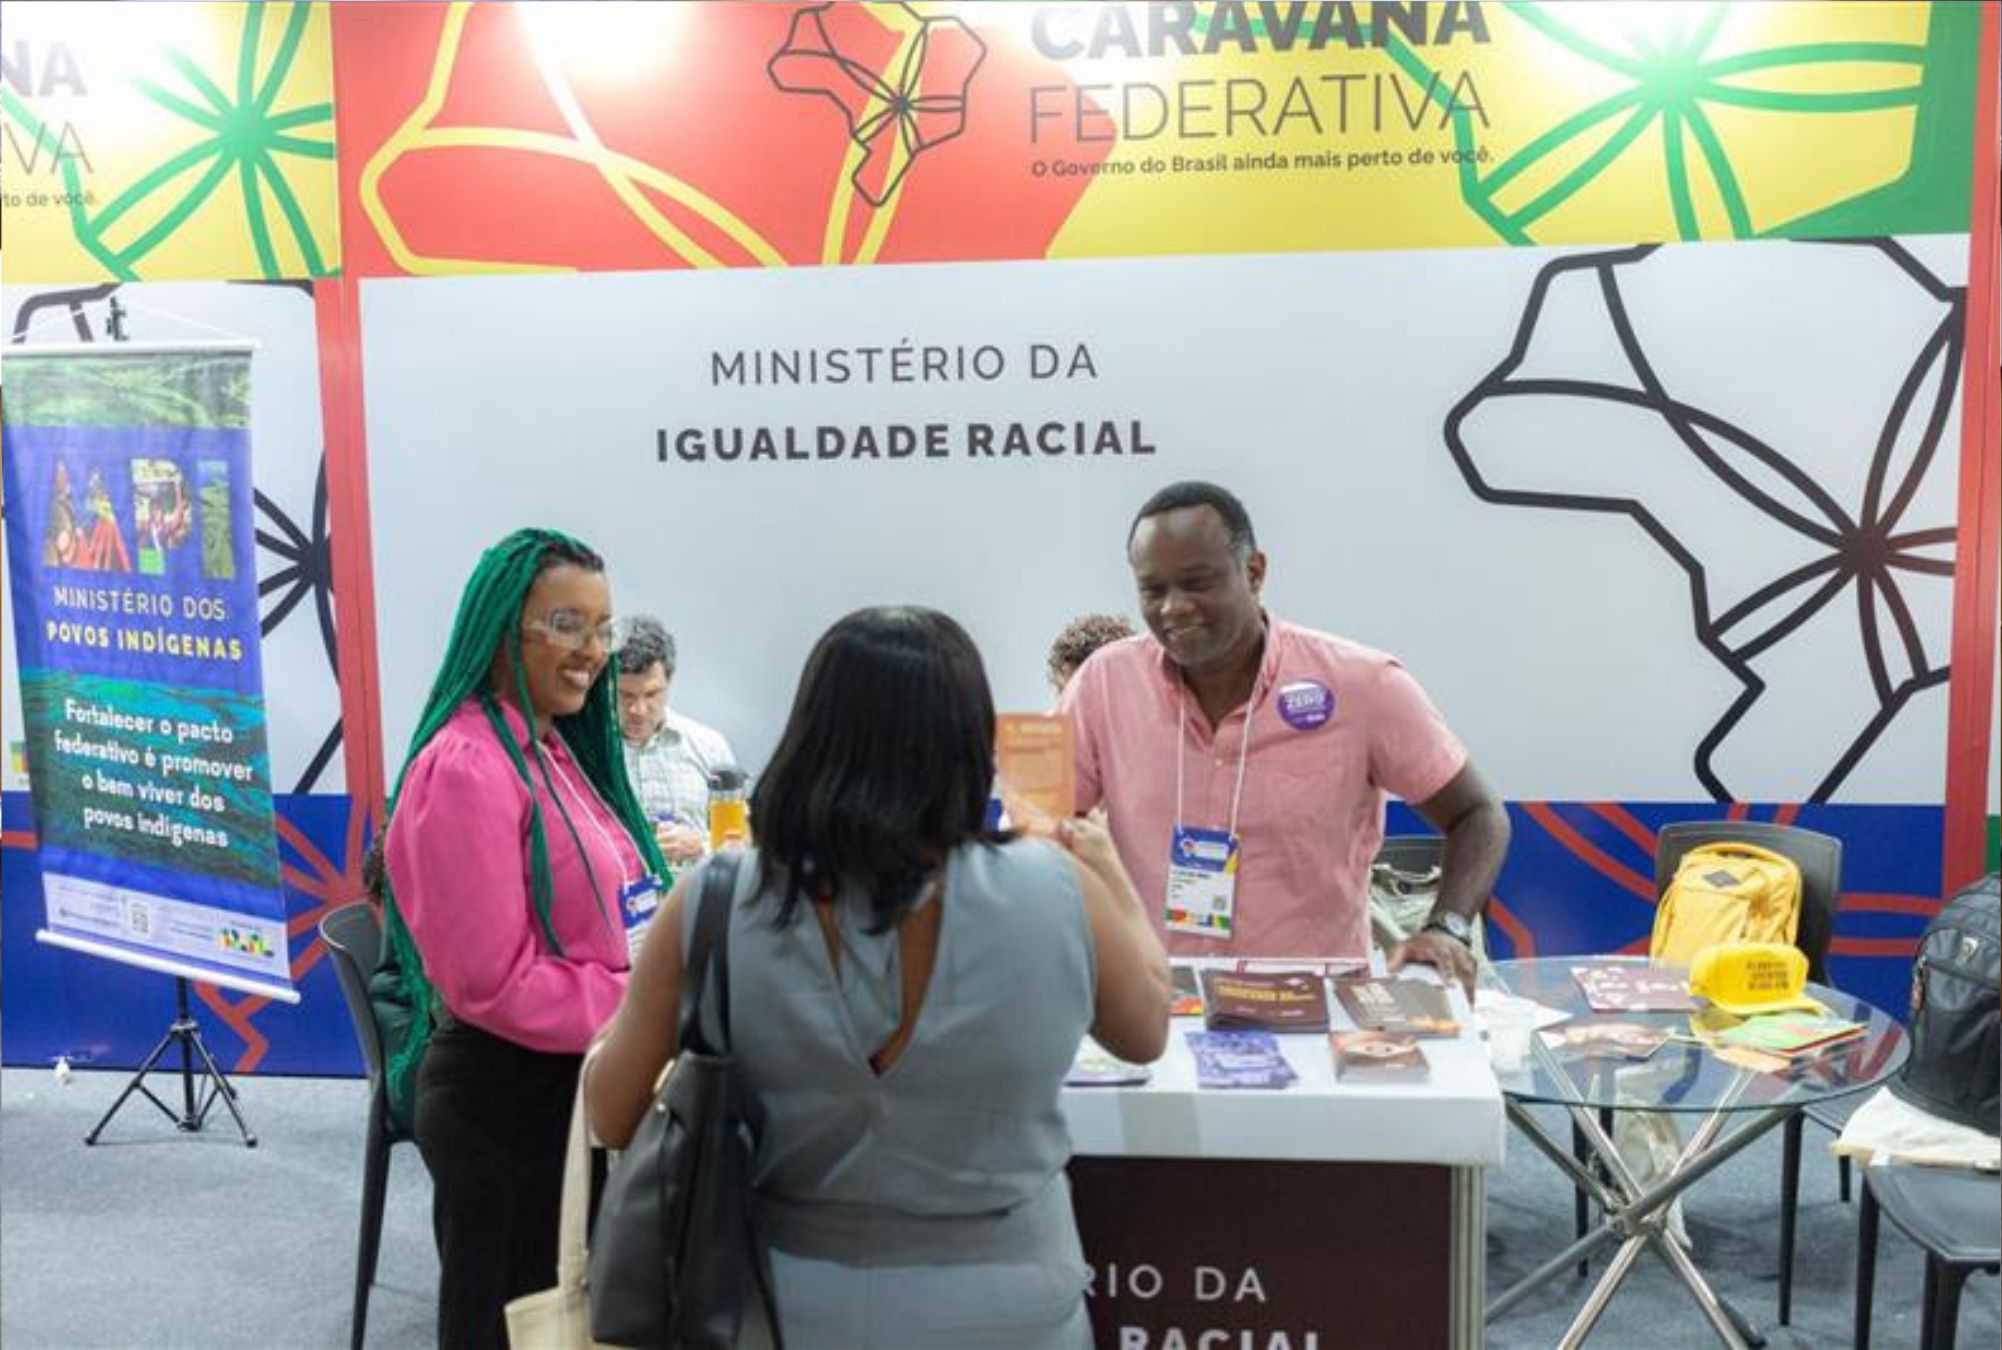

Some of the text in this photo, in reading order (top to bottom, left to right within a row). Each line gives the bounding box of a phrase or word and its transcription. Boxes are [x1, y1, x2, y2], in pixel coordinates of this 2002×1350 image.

[1031, 1, 1492, 60] CARAVANA
[1030, 70, 1492, 144] FEDERATIVA
[1031, 145, 1494, 177] O Governo do Brasil ainda mais perto de você.
[710, 338, 1099, 386] MINISTÉRIO DA
[656, 420, 1157, 462] IGUALDADE RACIAL
[53, 586, 227, 620] MINISTÉRIO DOS
[46, 621, 243, 661] POVOS INDÍGENAS
[65, 699, 234, 744] Fortalecer o pacto
[54, 731, 254, 781] federativo é promover
[82, 770, 226, 813] o bem viver dos
[84, 806, 134, 830] povos
[1194, 1266, 1267, 1302] DA
